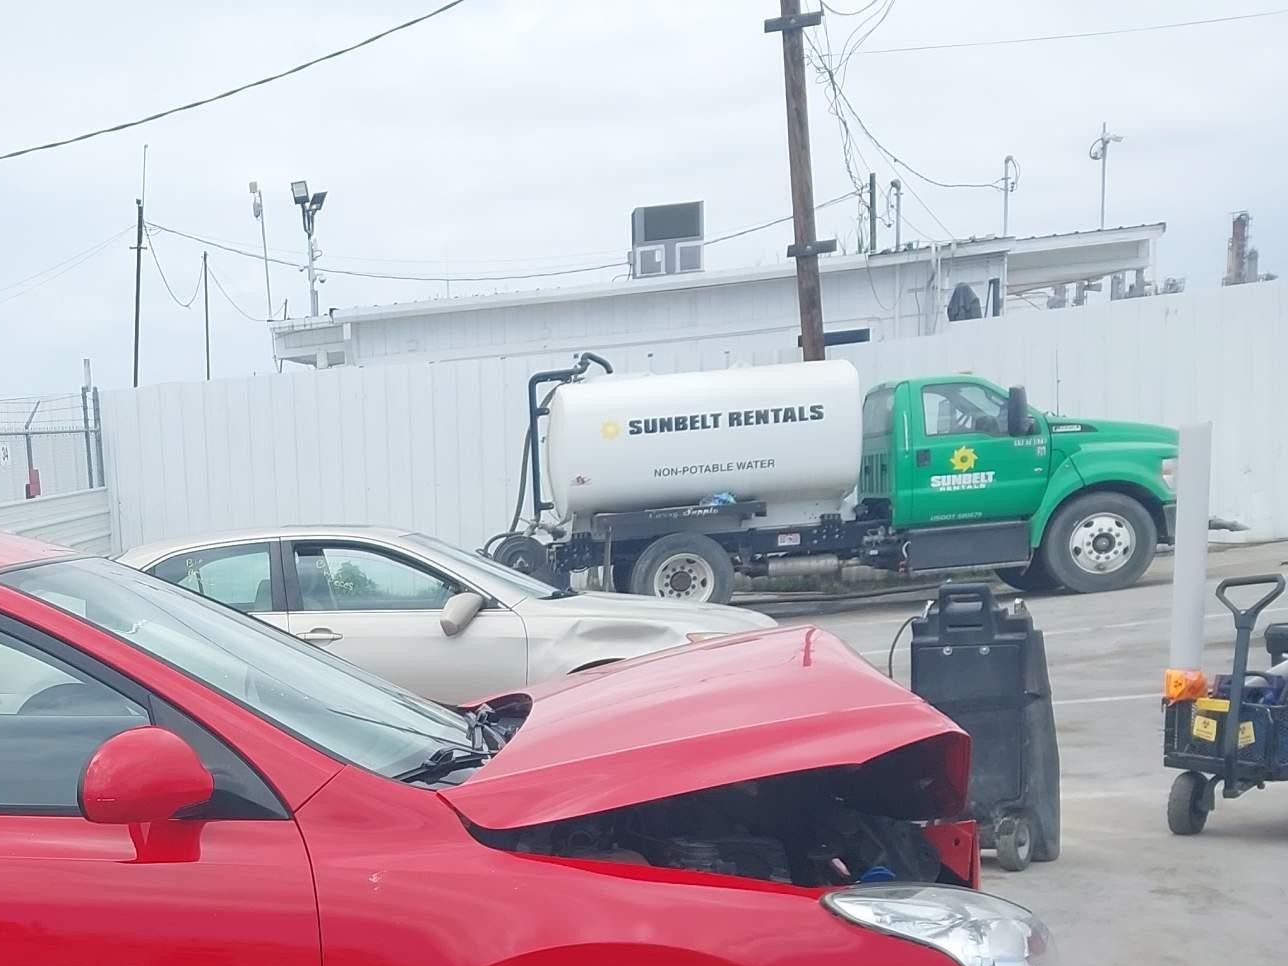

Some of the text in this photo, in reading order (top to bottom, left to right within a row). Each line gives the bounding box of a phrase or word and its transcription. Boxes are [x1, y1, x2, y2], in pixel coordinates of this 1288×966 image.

[628, 404, 824, 435] SUNBELT RENTALS
[653, 458, 777, 478] NON-POTABLE WATER
[930, 471, 996, 488] SUNBELT
